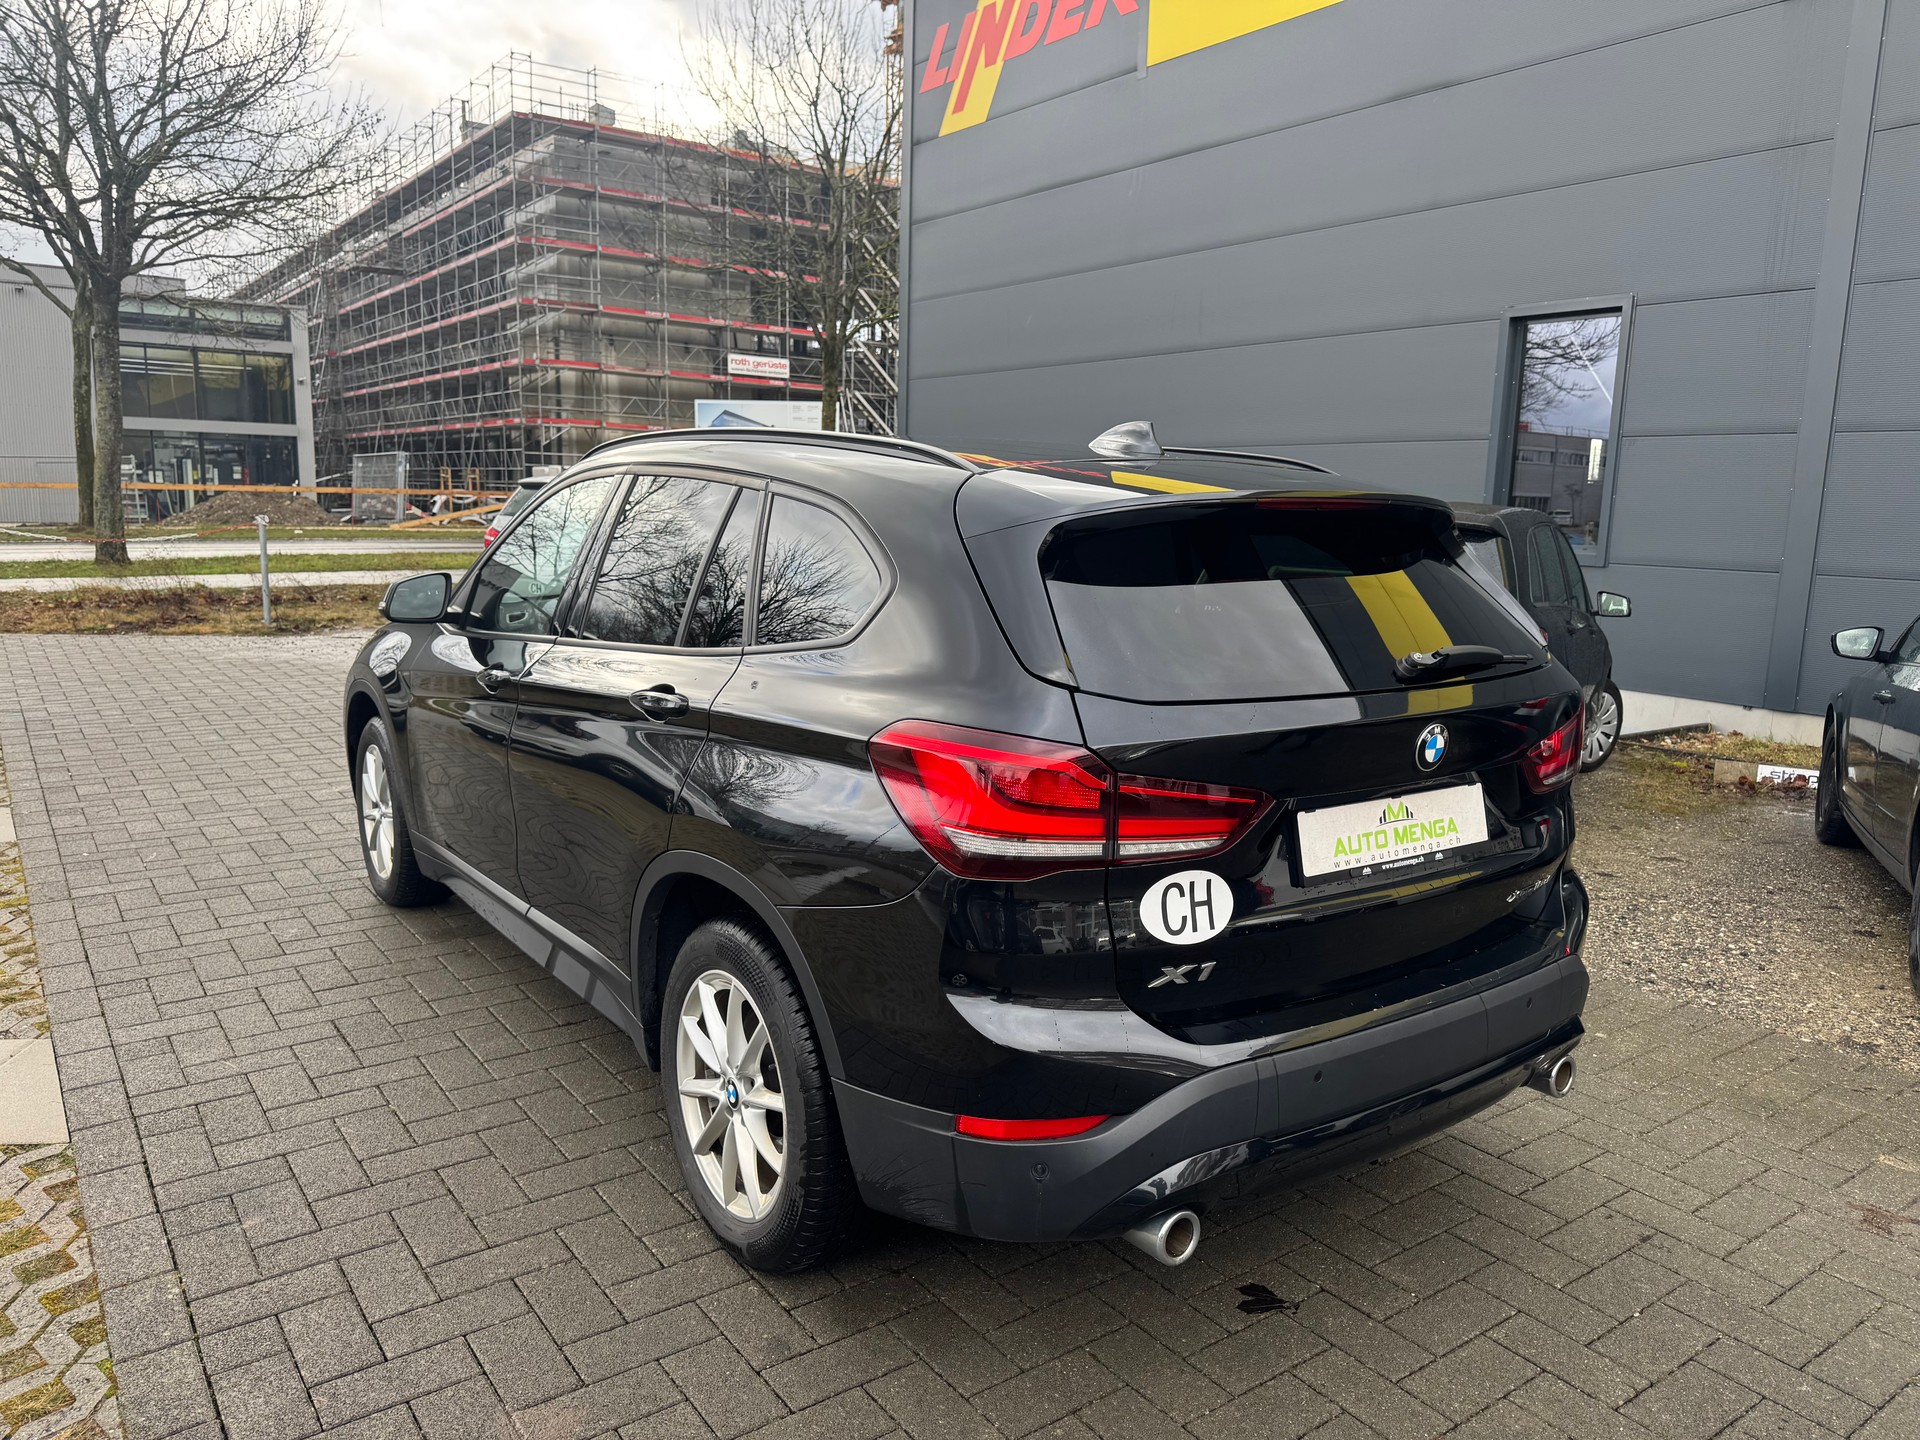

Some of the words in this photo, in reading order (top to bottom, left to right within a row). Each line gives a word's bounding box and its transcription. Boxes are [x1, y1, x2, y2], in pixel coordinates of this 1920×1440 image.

[731, 358, 750, 366] roth
[752, 360, 788, 370] gerüste
[1333, 829, 1389, 857] AUTO
[1394, 817, 1459, 846] MENGA
[1333, 835, 1461, 869] www.automenga.ch
[1161, 878, 1216, 936] CH
[1148, 961, 1216, 988] X1
